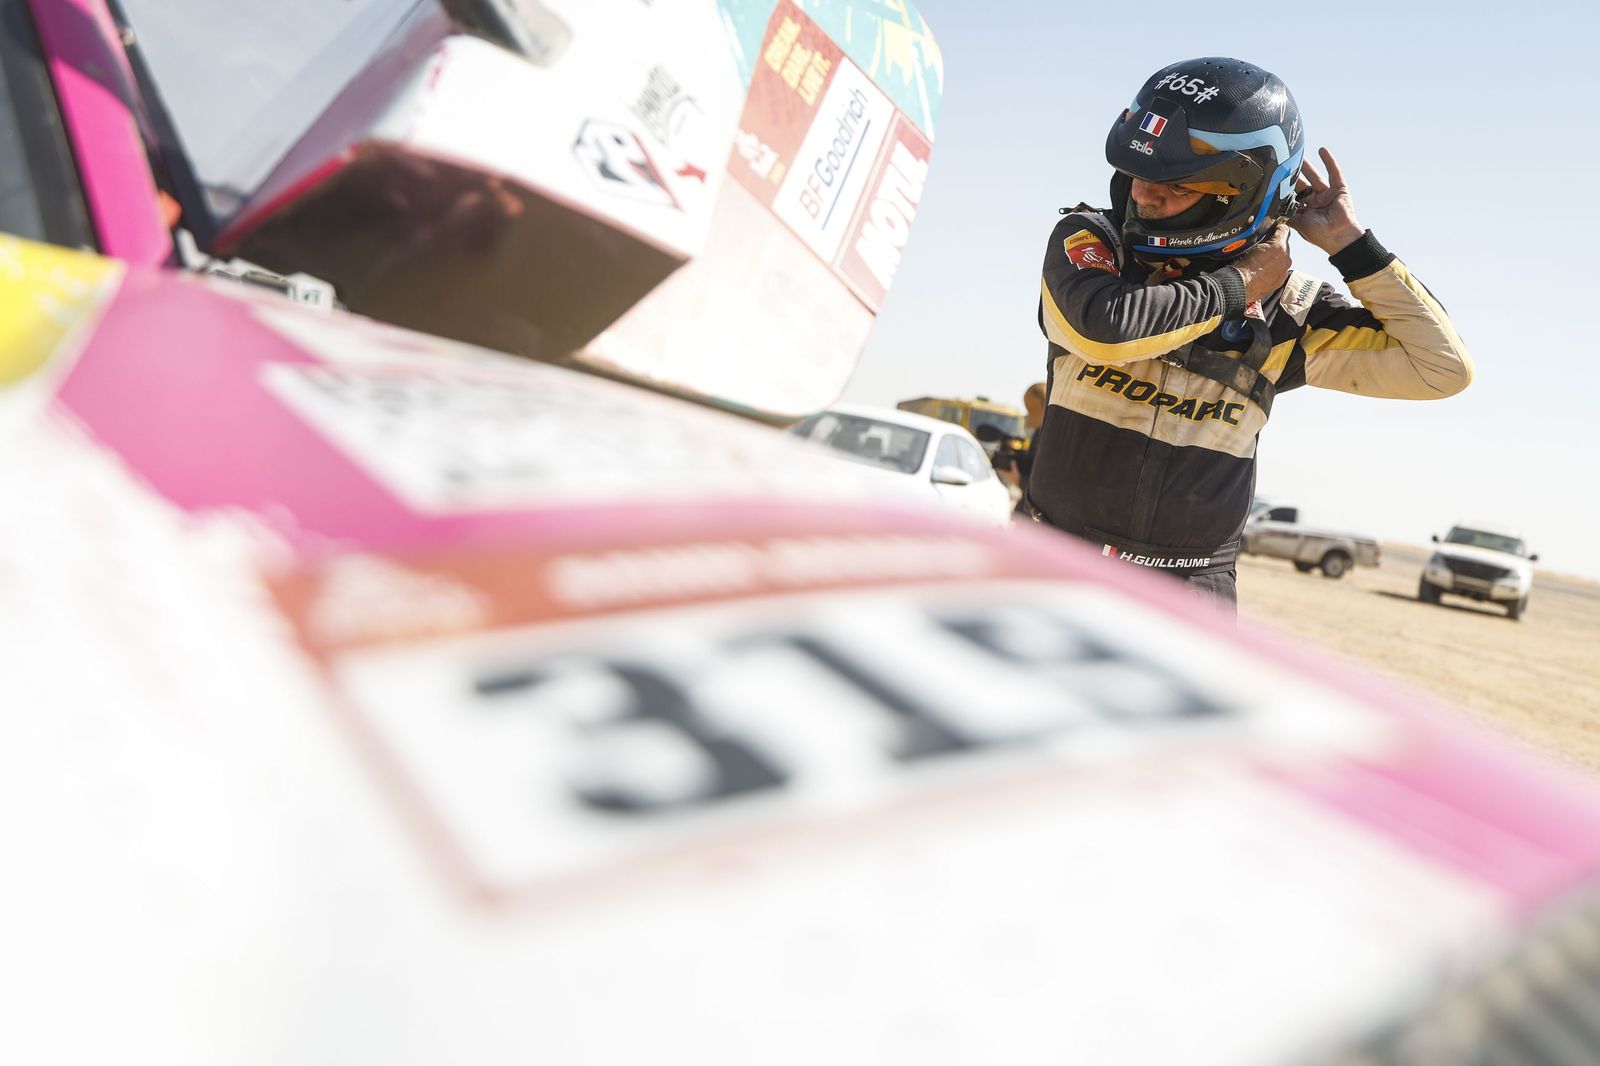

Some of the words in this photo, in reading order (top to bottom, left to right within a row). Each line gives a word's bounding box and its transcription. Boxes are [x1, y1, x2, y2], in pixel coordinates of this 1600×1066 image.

[1154, 72, 1220, 104] #65#
[799, 87, 869, 221] BFGoodrich
[1193, 231, 1230, 245] Guillaume
[1076, 362, 1245, 427] PROPARC
[1119, 551, 1211, 568] H.GUILLAUME
